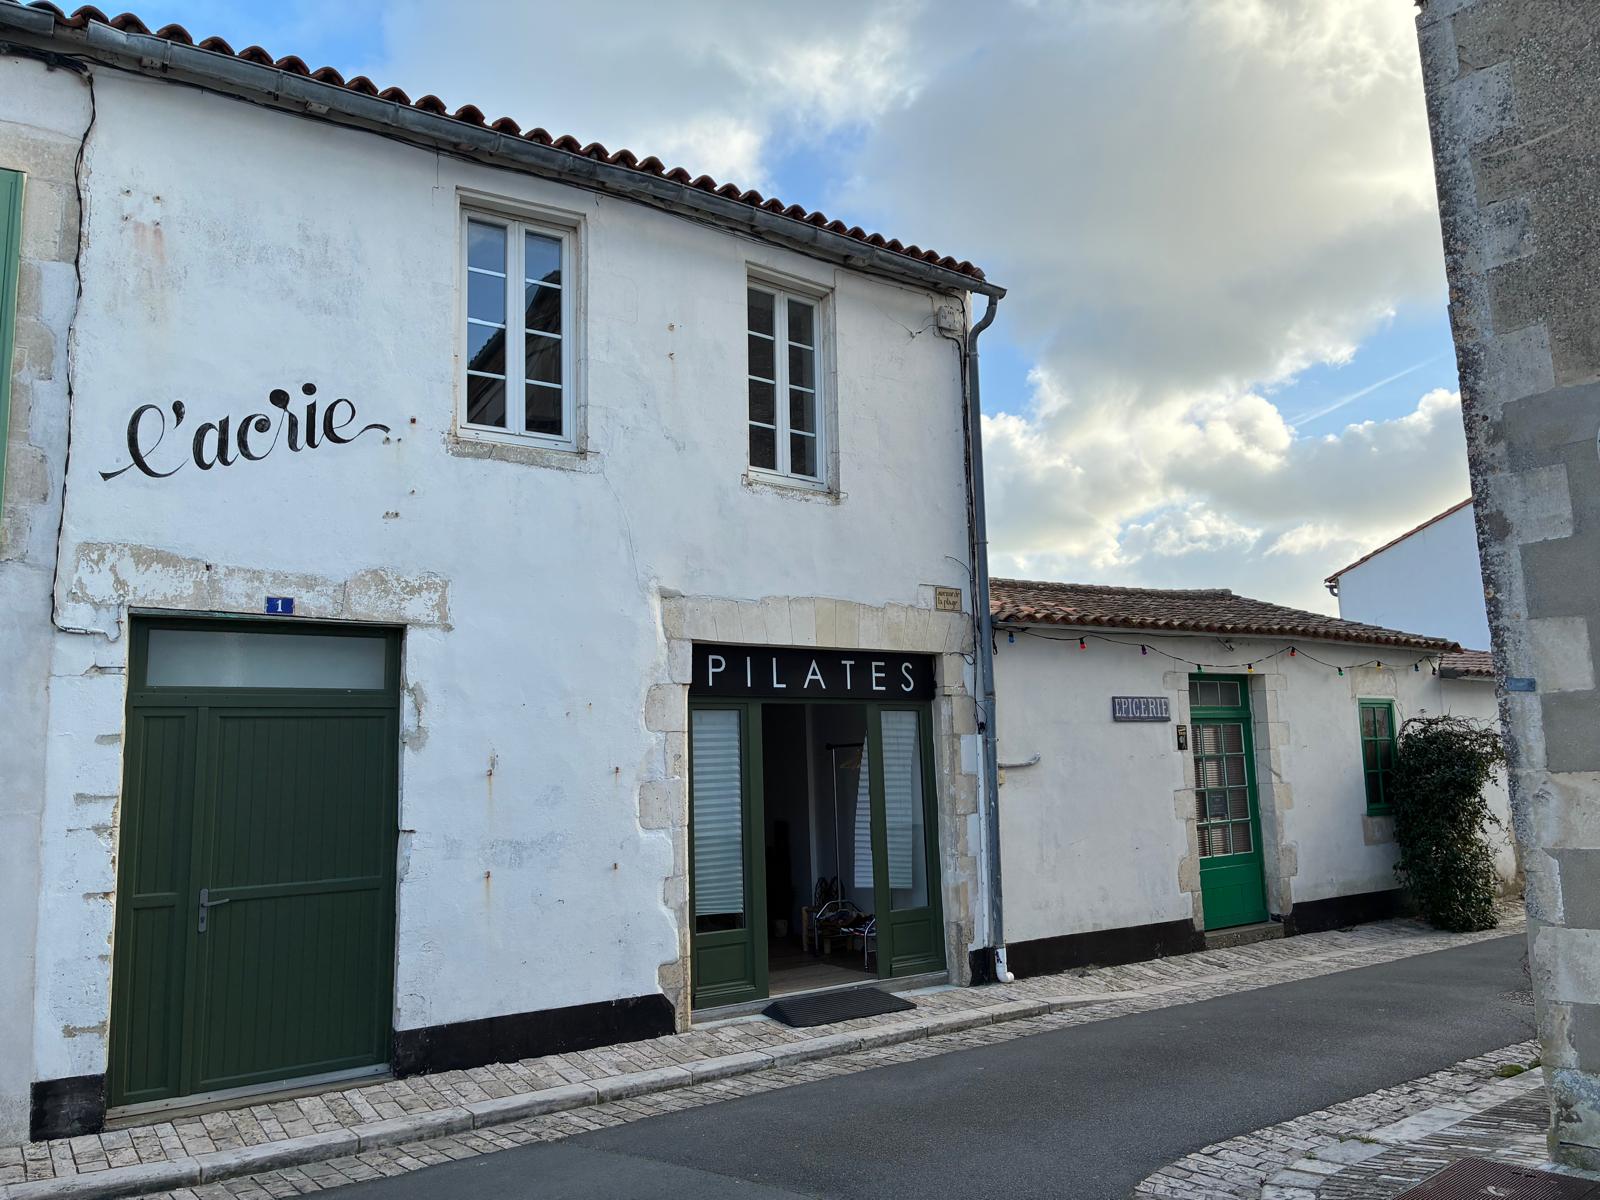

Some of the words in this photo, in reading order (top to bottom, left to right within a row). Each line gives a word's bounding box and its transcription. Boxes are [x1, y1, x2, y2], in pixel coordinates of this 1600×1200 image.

[276, 599, 283, 612] 1
[707, 654, 916, 692] PILATES
[1114, 697, 1169, 717] EPICERIE
